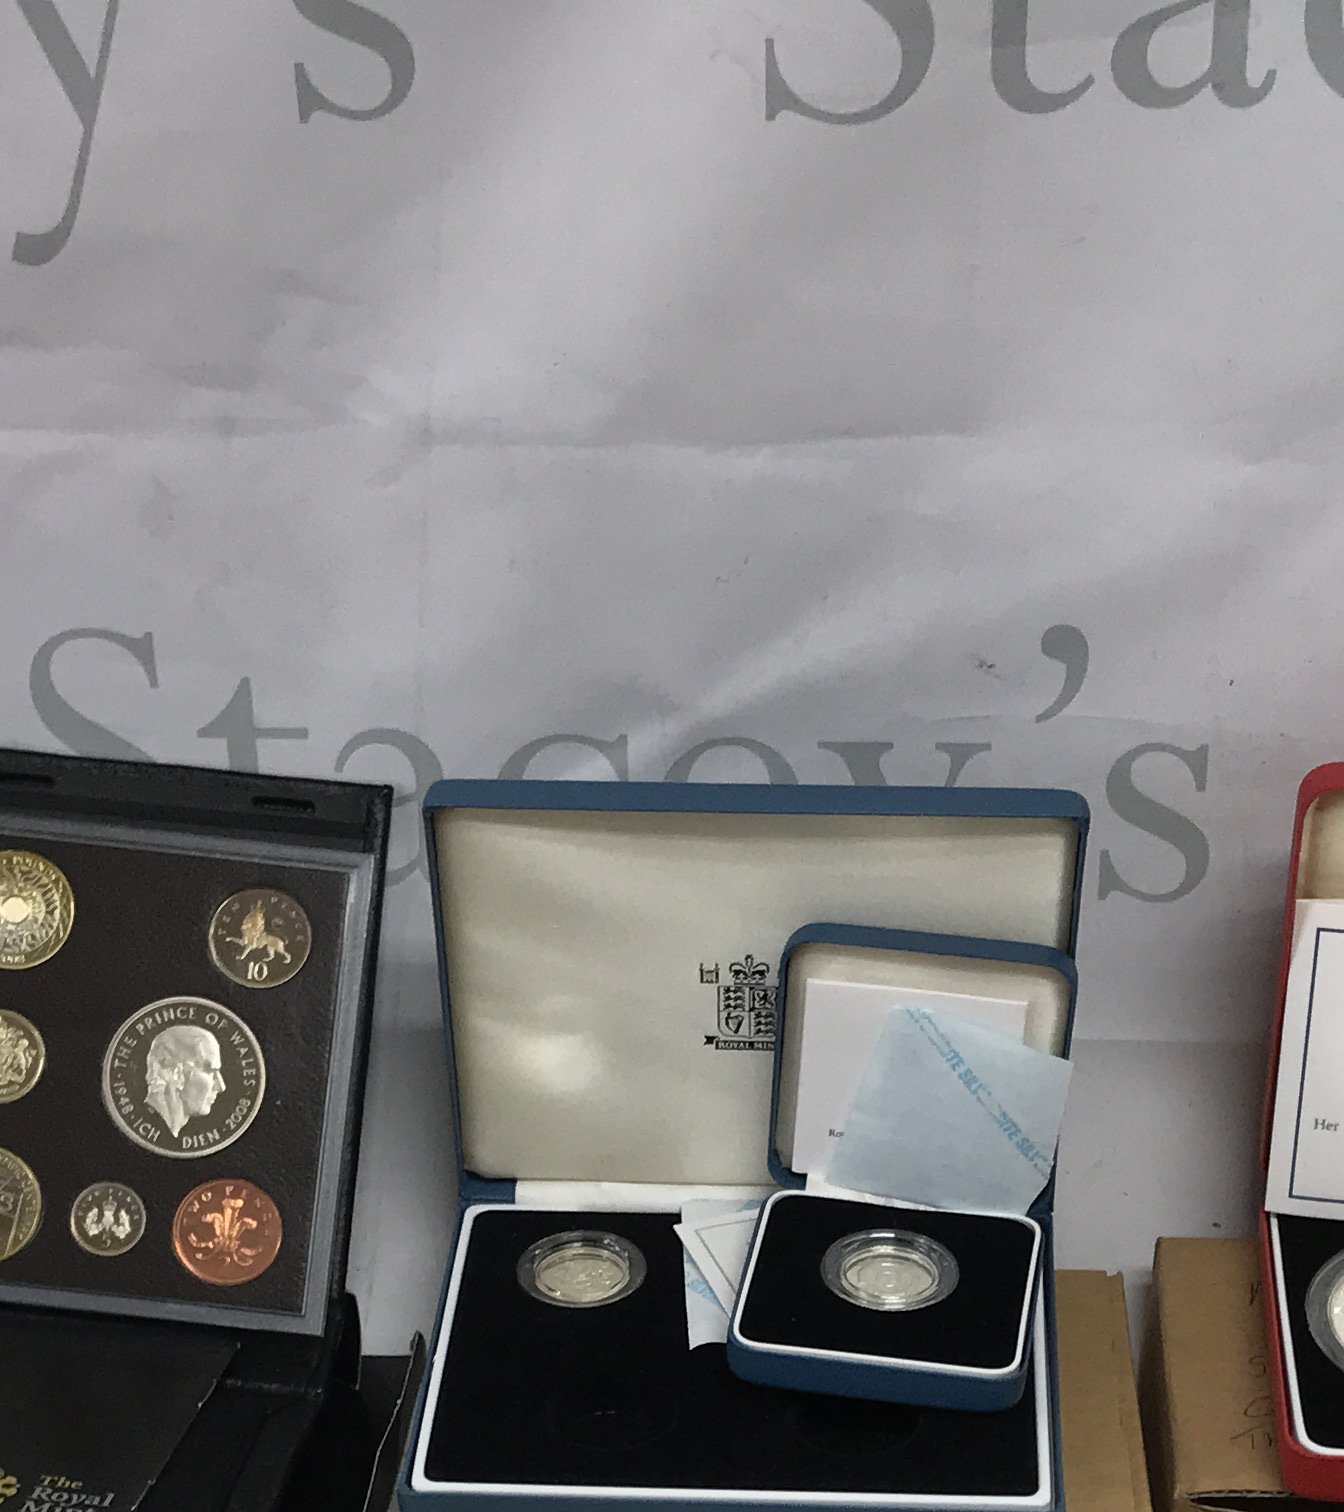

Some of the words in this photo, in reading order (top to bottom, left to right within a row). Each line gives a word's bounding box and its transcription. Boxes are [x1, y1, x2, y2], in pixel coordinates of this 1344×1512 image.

[247, 961, 269, 981] 10
[113, 1035, 138, 1070] THE
[135, 1006, 198, 1036] PRINCE
[205, 1011, 229, 1030] OF
[229, 1030, 256, 1088] WALES
[225, 1098, 252, 1131] 2008
[1313, 1117, 1340, 1134] Her
[181, 1128, 221, 1149] DIEN
[40, 1474, 84, 1490] The
[30, 1486, 116, 1508] Royal
